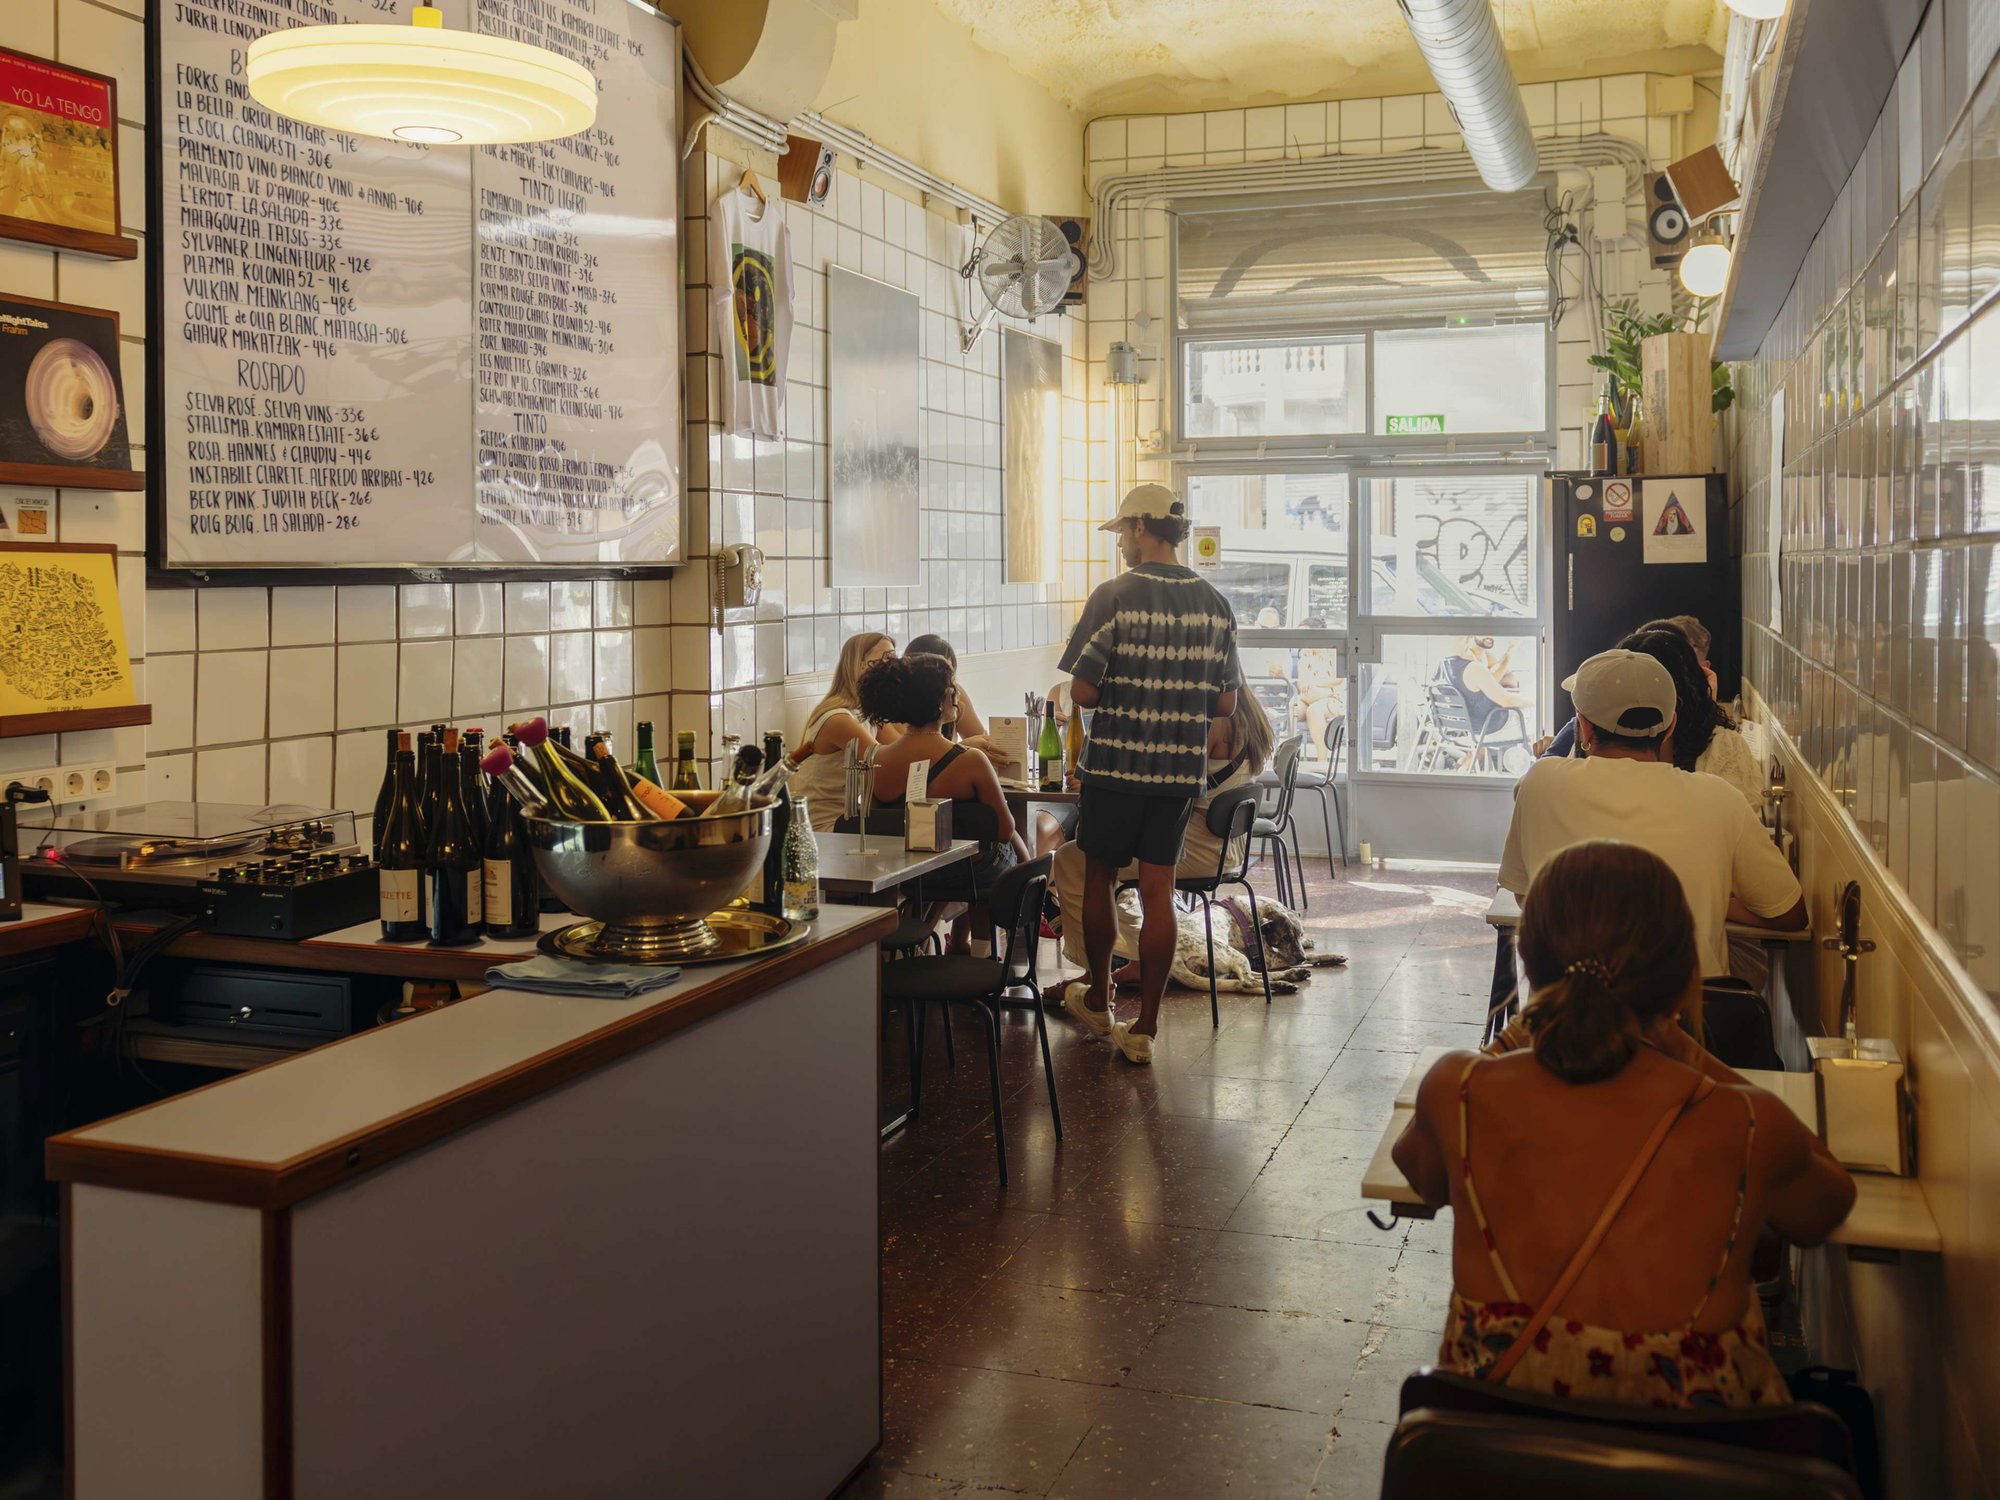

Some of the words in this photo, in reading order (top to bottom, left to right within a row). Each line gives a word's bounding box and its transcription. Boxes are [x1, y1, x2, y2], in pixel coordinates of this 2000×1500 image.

[177, 63, 218, 93] FORKS
[12, 86, 33, 104] YO
[36, 92, 55, 110] LA
[56, 97, 102, 122] TENGO
[177, 91, 192, 109] LA
[242, 106, 273, 130] ORIOL
[277, 117, 326, 147] ARTIGAS
[178, 114, 193, 134] EL
[233, 125, 296, 161] CLANDESTI
[179, 137, 243, 170] PALMENTO
[247, 155, 277, 179] VINO
[328, 176, 353, 198] VINO
[367, 188, 397, 210] ANNA
[248, 177, 260, 195] VE
[243, 196, 258, 215] LA
[260, 201, 309, 227] SALADA
[520, 177, 554, 204] TINTO
[558, 188, 587, 216] LIGERO
[267, 223, 309, 247] TATSIS
[255, 242, 335, 273] LINGENFELDER
[243, 262, 295, 288] KOLONIA
[298, 271, 314, 288] 52
[247, 284, 320, 314] MEINKLANG
[480, 282, 508, 300] KARMA
[185, 301, 230, 325] COUME
[235, 309, 247, 324] de
[250, 310, 275, 332] OLLA
[324, 318, 377, 344] MATASSA
[479, 301, 524, 320] CONTROLLED
[184, 322, 227, 349] GHAUR
[232, 329, 301, 358] MAKATZAK
[238, 359, 305, 396] ROSADO
[185, 392, 225, 414] SELVA
[264, 398, 301, 421] SELVA
[304, 404, 333, 423] VINS
[256, 420, 305, 441] KAMARA
[309, 424, 345, 444] ESTATE
[514, 413, 547, 434] TINTO
[1389, 416, 1441, 433] SALIDA
[228, 443, 276, 462] HANNES
[291, 446, 337, 465] CLAUDIU
[190, 466, 253, 484] INSTABILE
[310, 467, 357, 487] ALFREDO
[362, 469, 403, 487] ARRIBAS
[190, 490, 221, 510] BECK
[262, 489, 306, 509] JUDITH
[311, 490, 339, 511] BECK
[190, 514, 221, 535] ROIG
[264, 513, 278, 533] LA
[282, 513, 325, 533] SALADA
